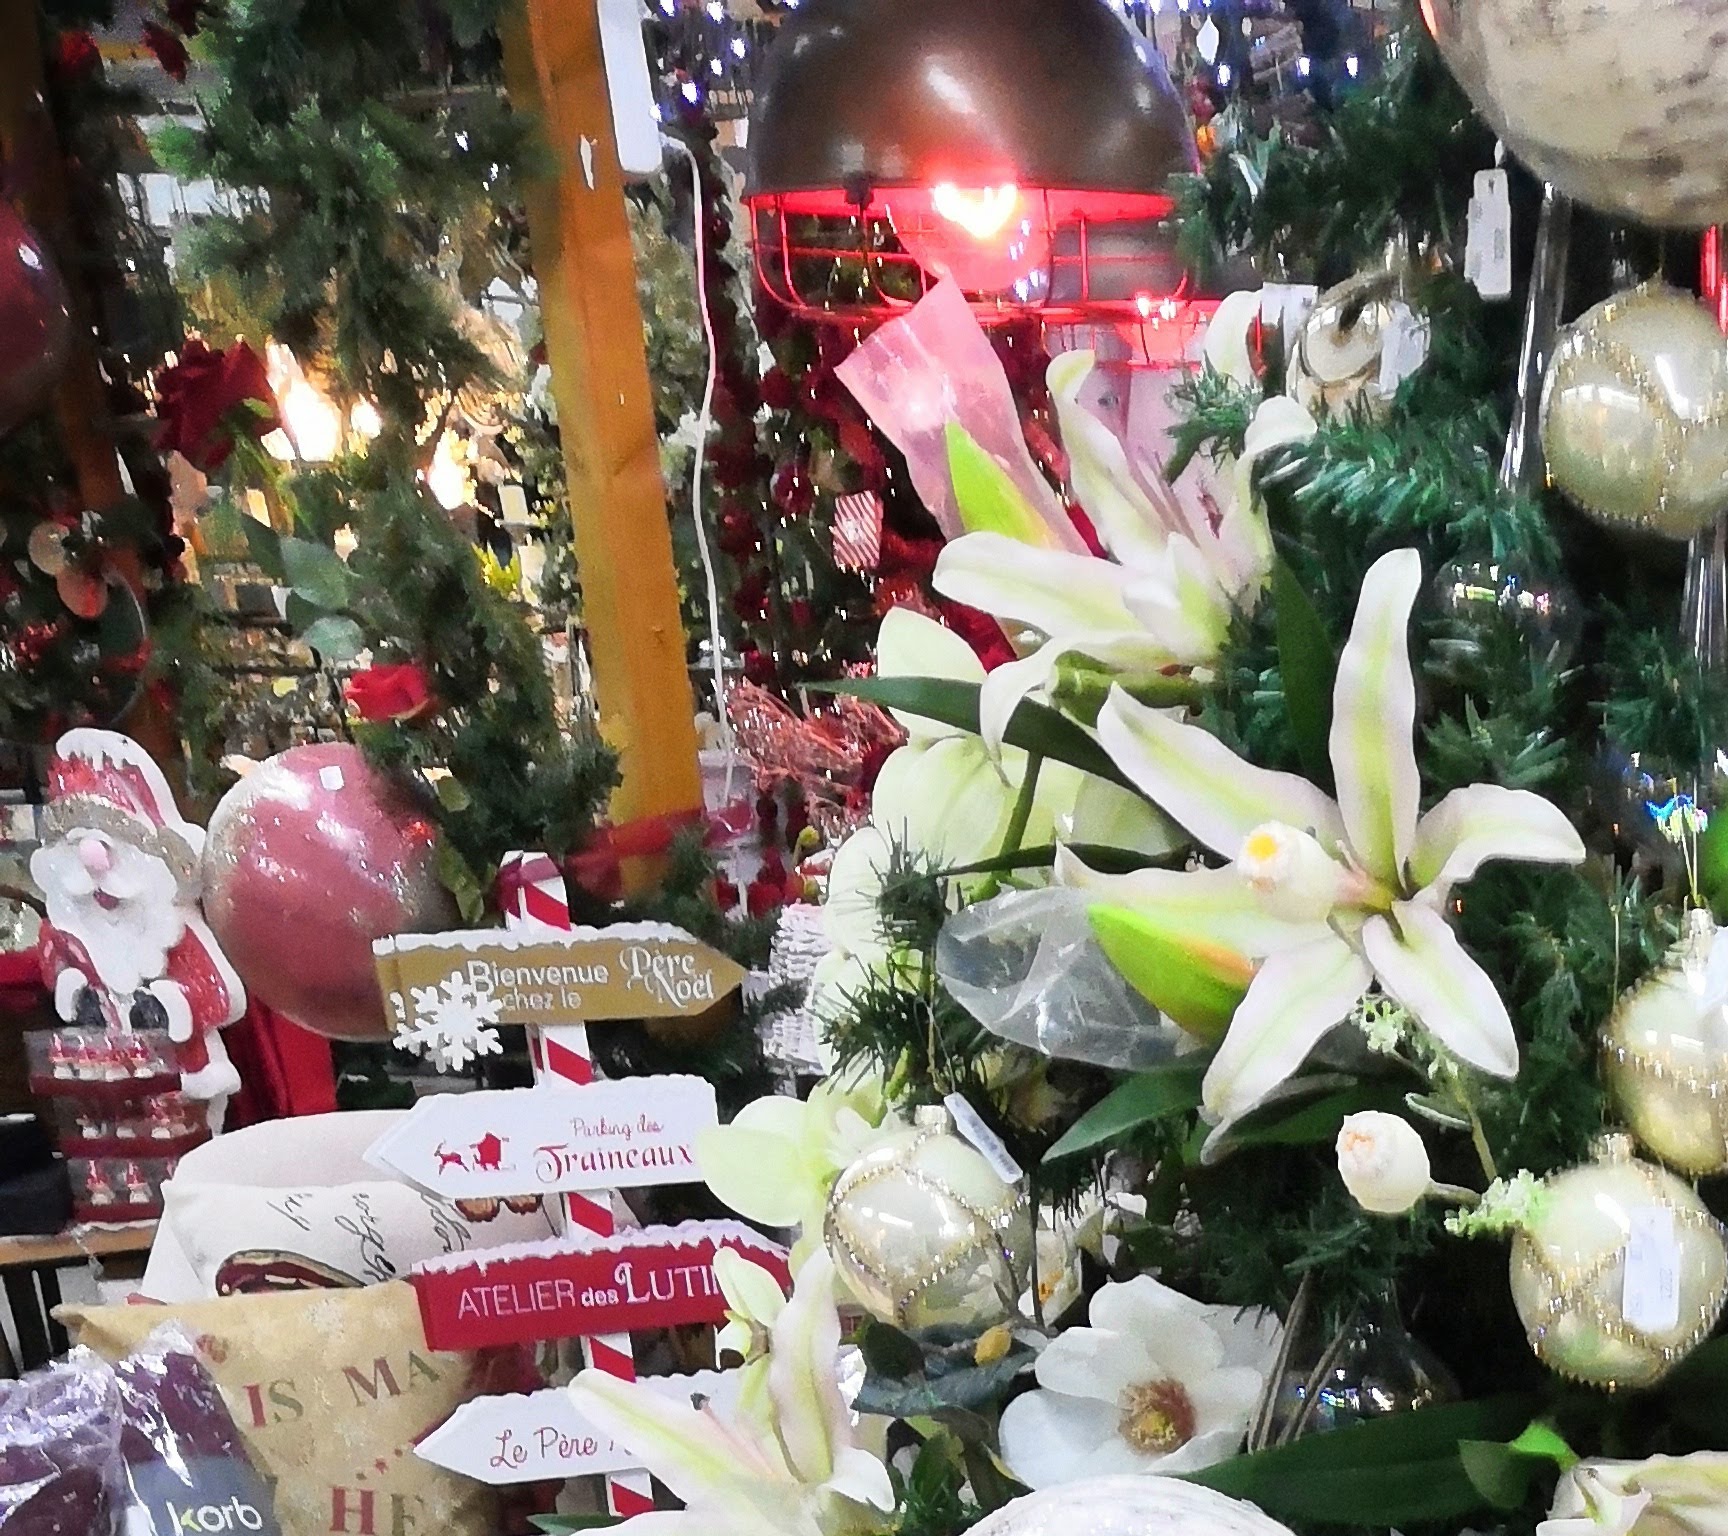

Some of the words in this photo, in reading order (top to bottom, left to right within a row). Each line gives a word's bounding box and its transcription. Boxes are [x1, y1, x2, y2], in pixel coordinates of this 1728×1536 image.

[466, 958, 610, 995] Bienvenue
[619, 946, 696, 989] Père
[501, 986, 554, 1011] chez
[561, 984, 582, 1009] le
[570, 1114, 632, 1144] Parking
[636, 1113, 665, 1134] des
[458, 1278, 577, 1319] ATELIER
[581, 1286, 620, 1307] des
[614, 1261, 720, 1304] LUTI
[490, 1428, 529, 1469] Le
[533, 1426, 599, 1460] Père
